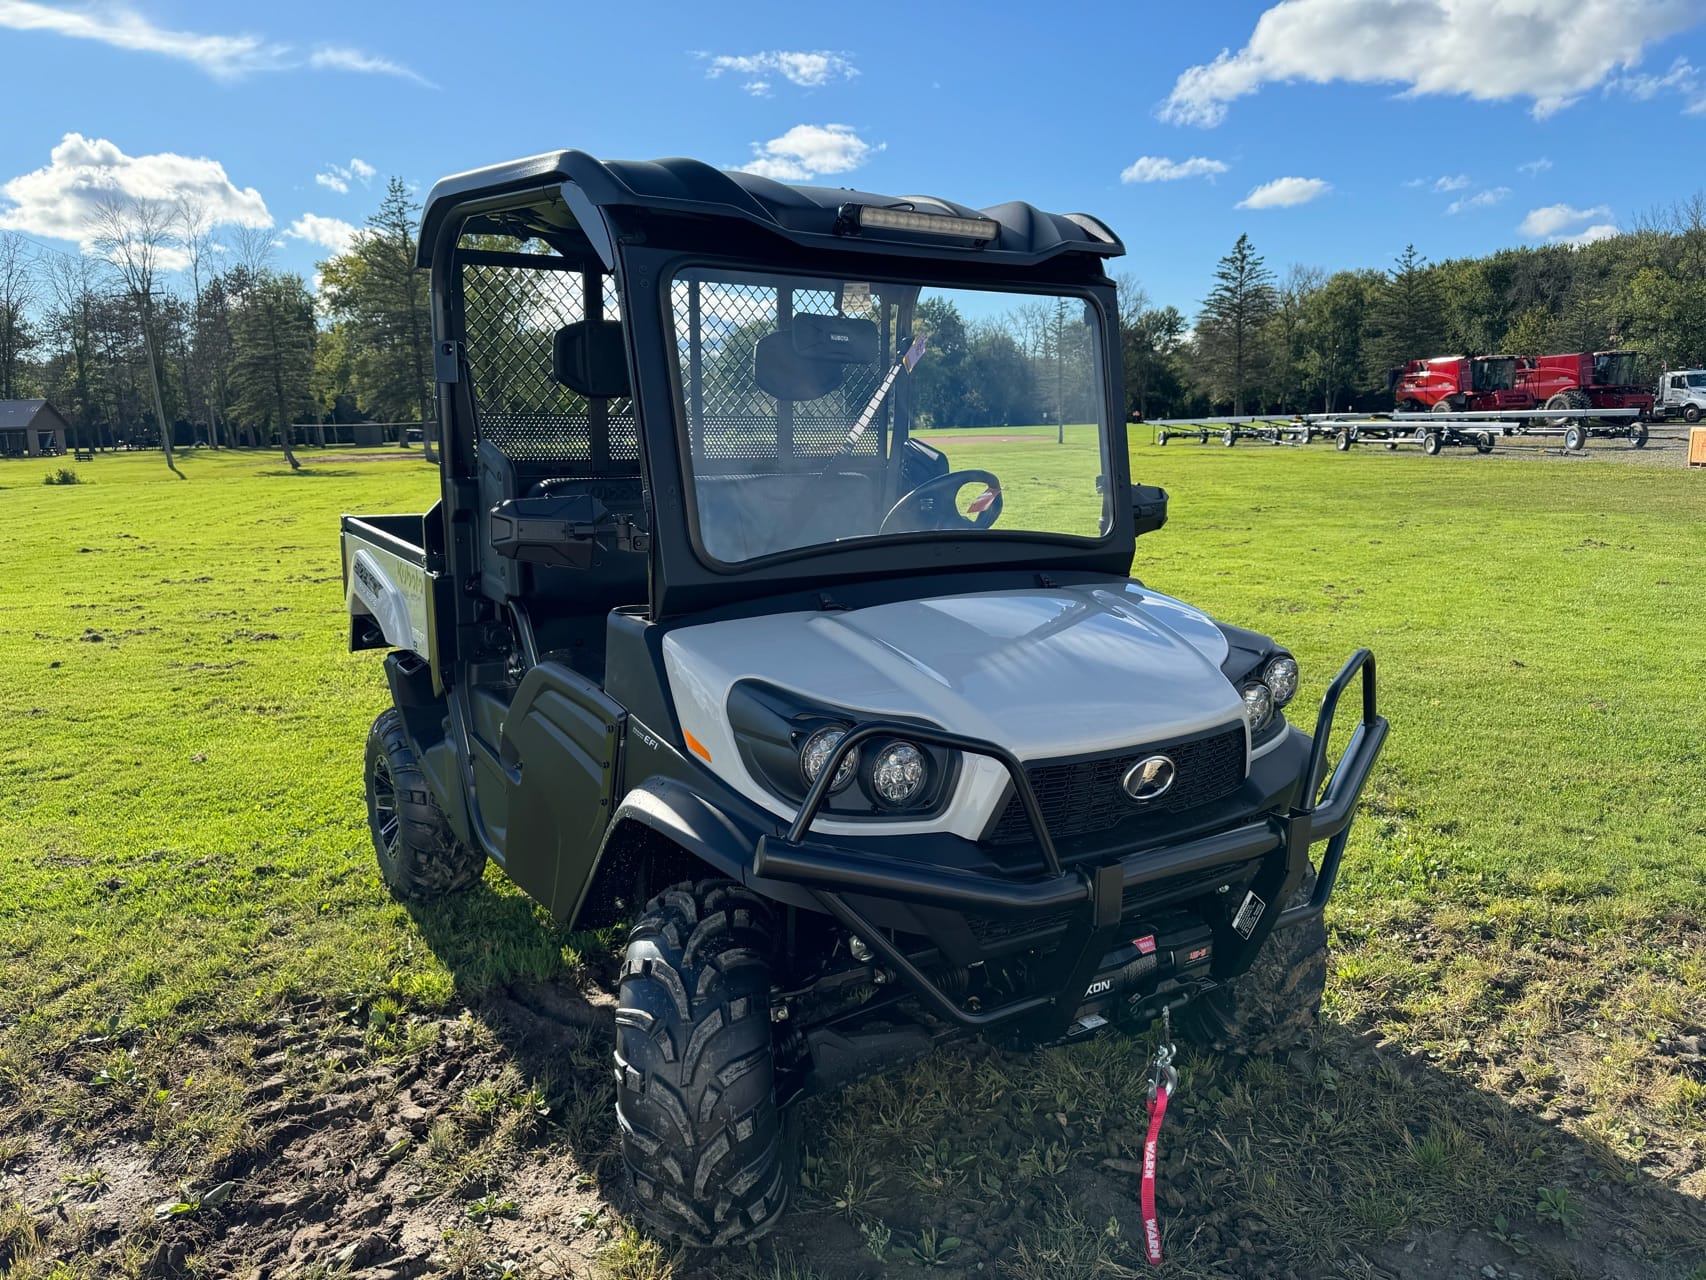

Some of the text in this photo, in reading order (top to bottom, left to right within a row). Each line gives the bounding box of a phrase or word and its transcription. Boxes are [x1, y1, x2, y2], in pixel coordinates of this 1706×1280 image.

[643, 735, 659, 750] EFI
[1083, 979, 1111, 998] XON
[1144, 1140, 1157, 1179] WARN
[1145, 1218, 1161, 1259] WARN
